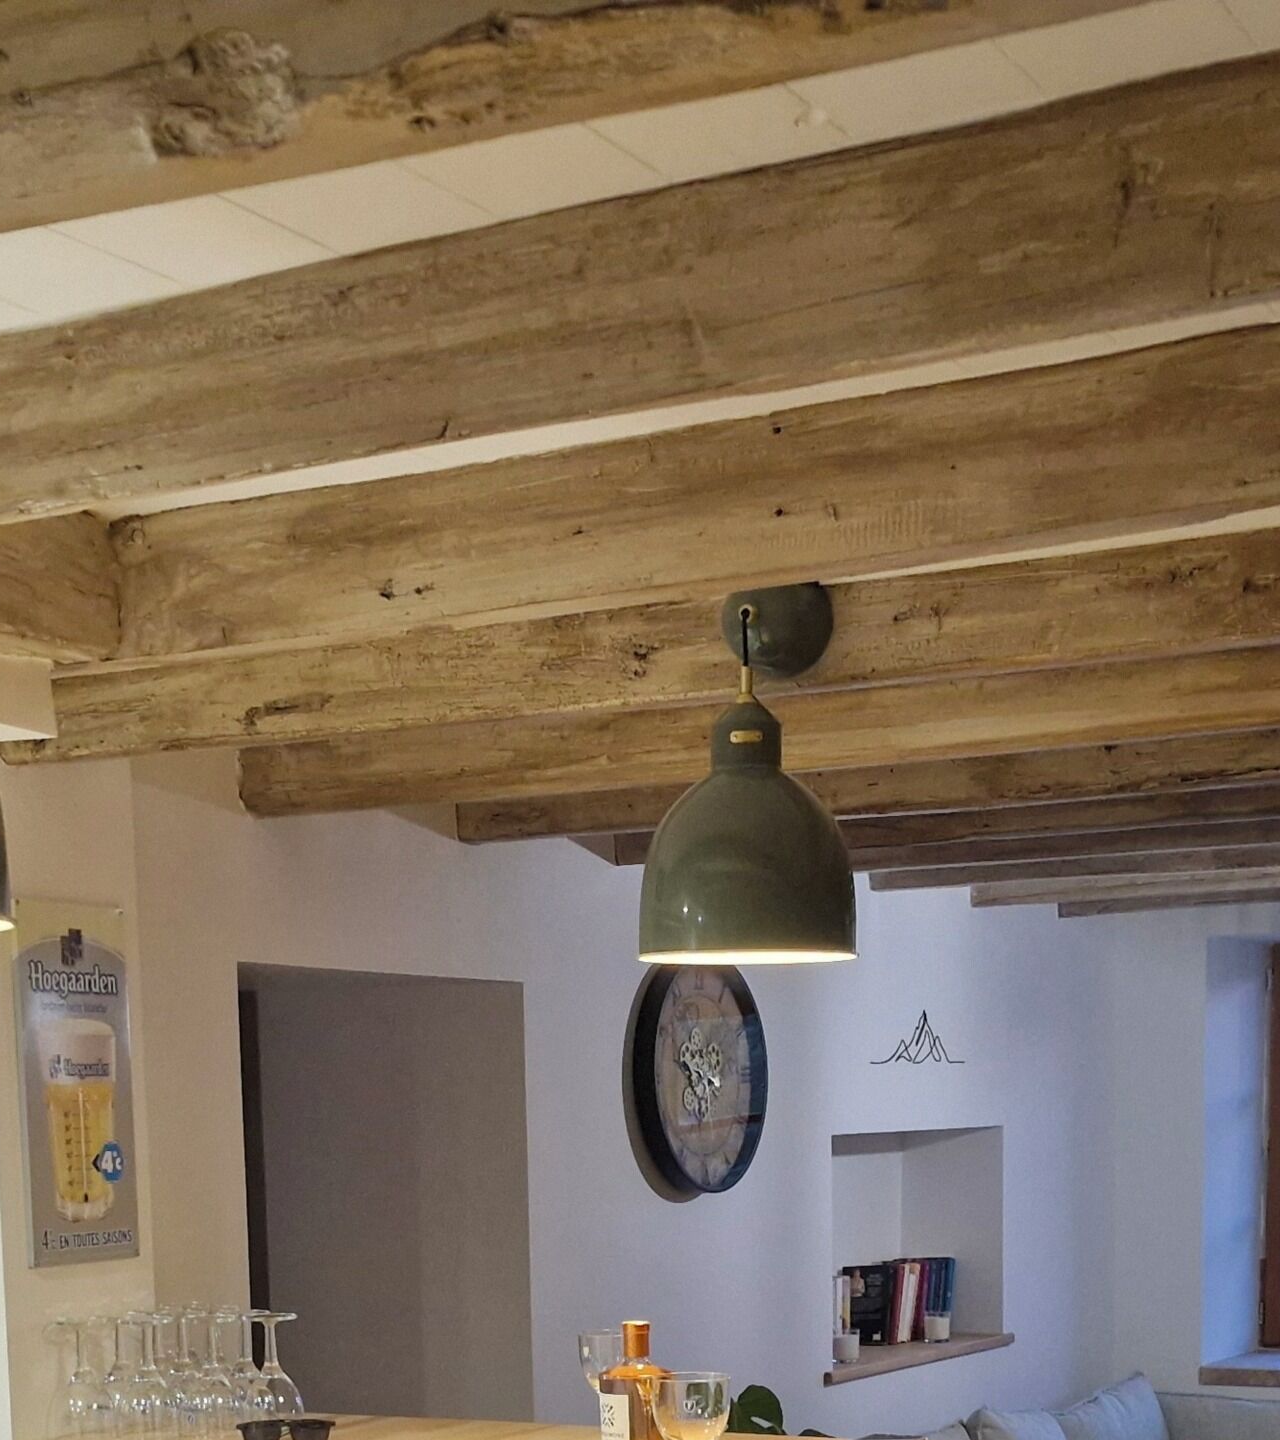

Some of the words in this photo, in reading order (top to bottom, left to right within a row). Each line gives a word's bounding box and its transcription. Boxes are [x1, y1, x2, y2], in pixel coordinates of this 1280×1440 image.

[28, 959, 119, 998] Hoegaarden
[59, 1235, 70, 1249] EN
[72, 1232, 100, 1248] TOUTES
[102, 1229, 133, 1245] SAISONS
